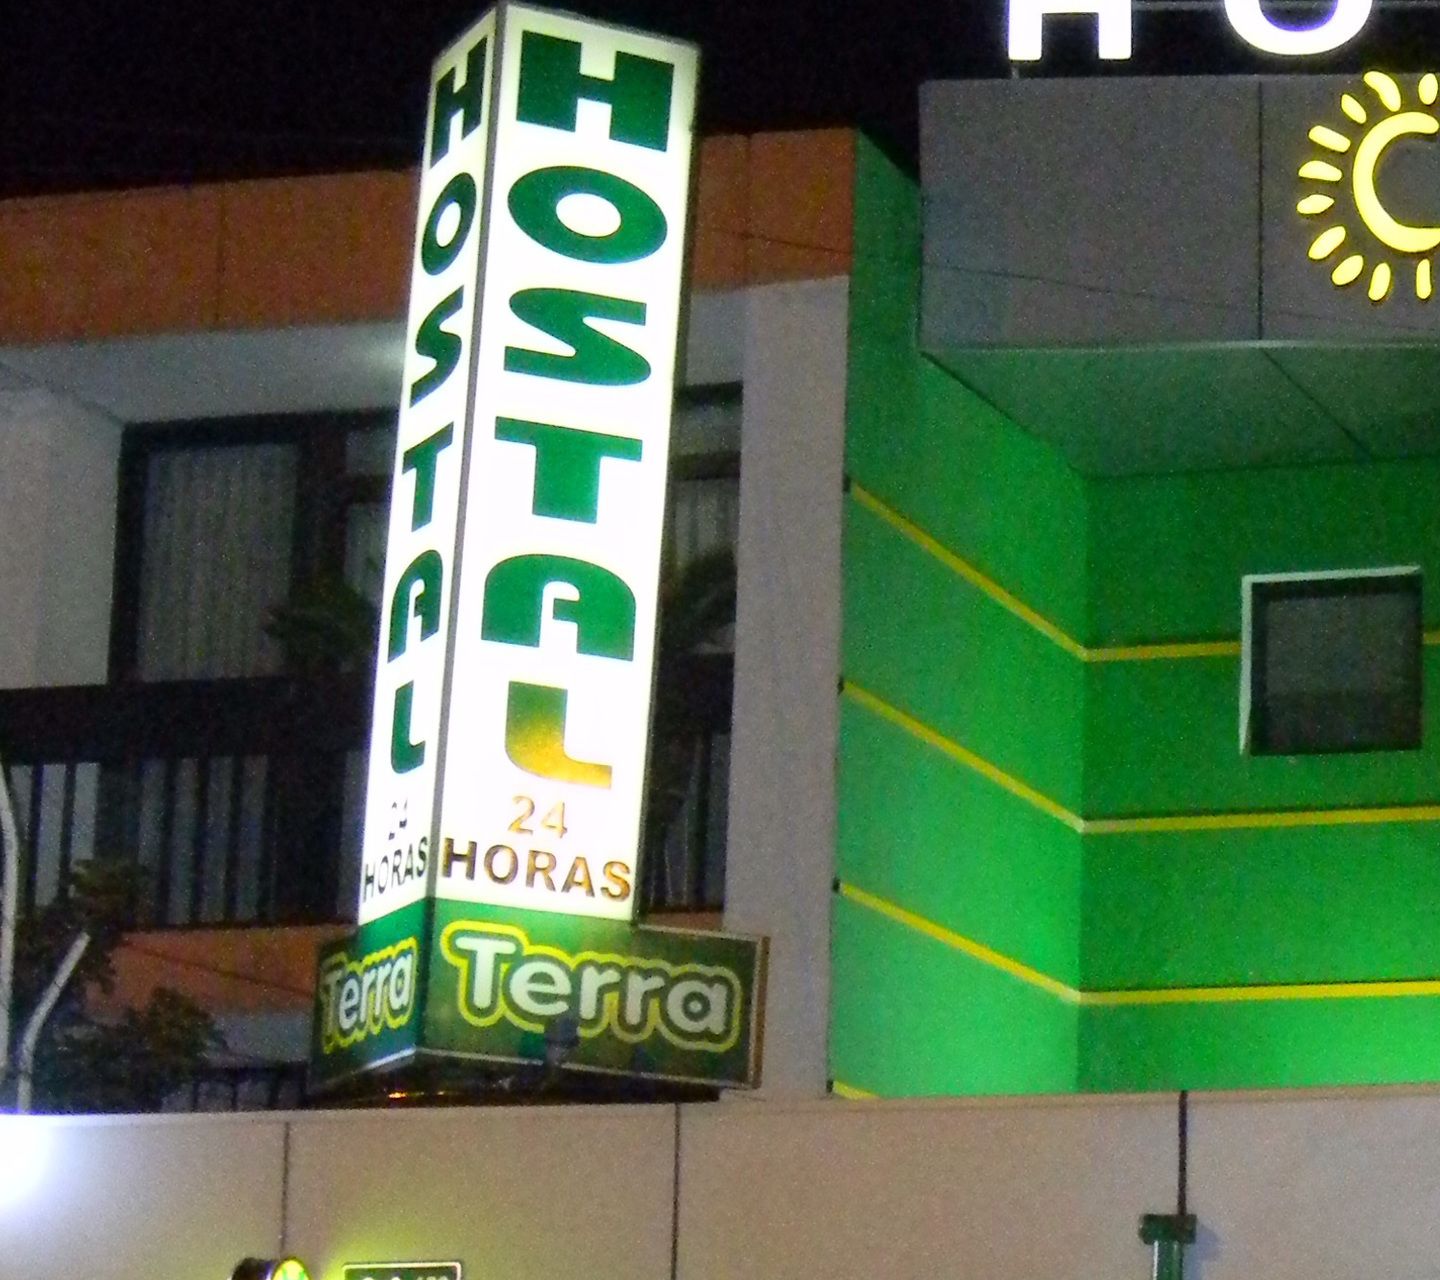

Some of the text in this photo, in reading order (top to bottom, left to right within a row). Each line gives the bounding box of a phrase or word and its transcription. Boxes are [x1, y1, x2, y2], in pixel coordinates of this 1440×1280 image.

[386, 36, 489, 775] HOSTAL
[480, 29, 676, 790] HOSTAL
[507, 795, 568, 839] 24
[362, 836, 428, 903] HORAS
[440, 835, 632, 903] HORAS
[323, 950, 414, 1035] Terra
[454, 935, 731, 1036] Terra
